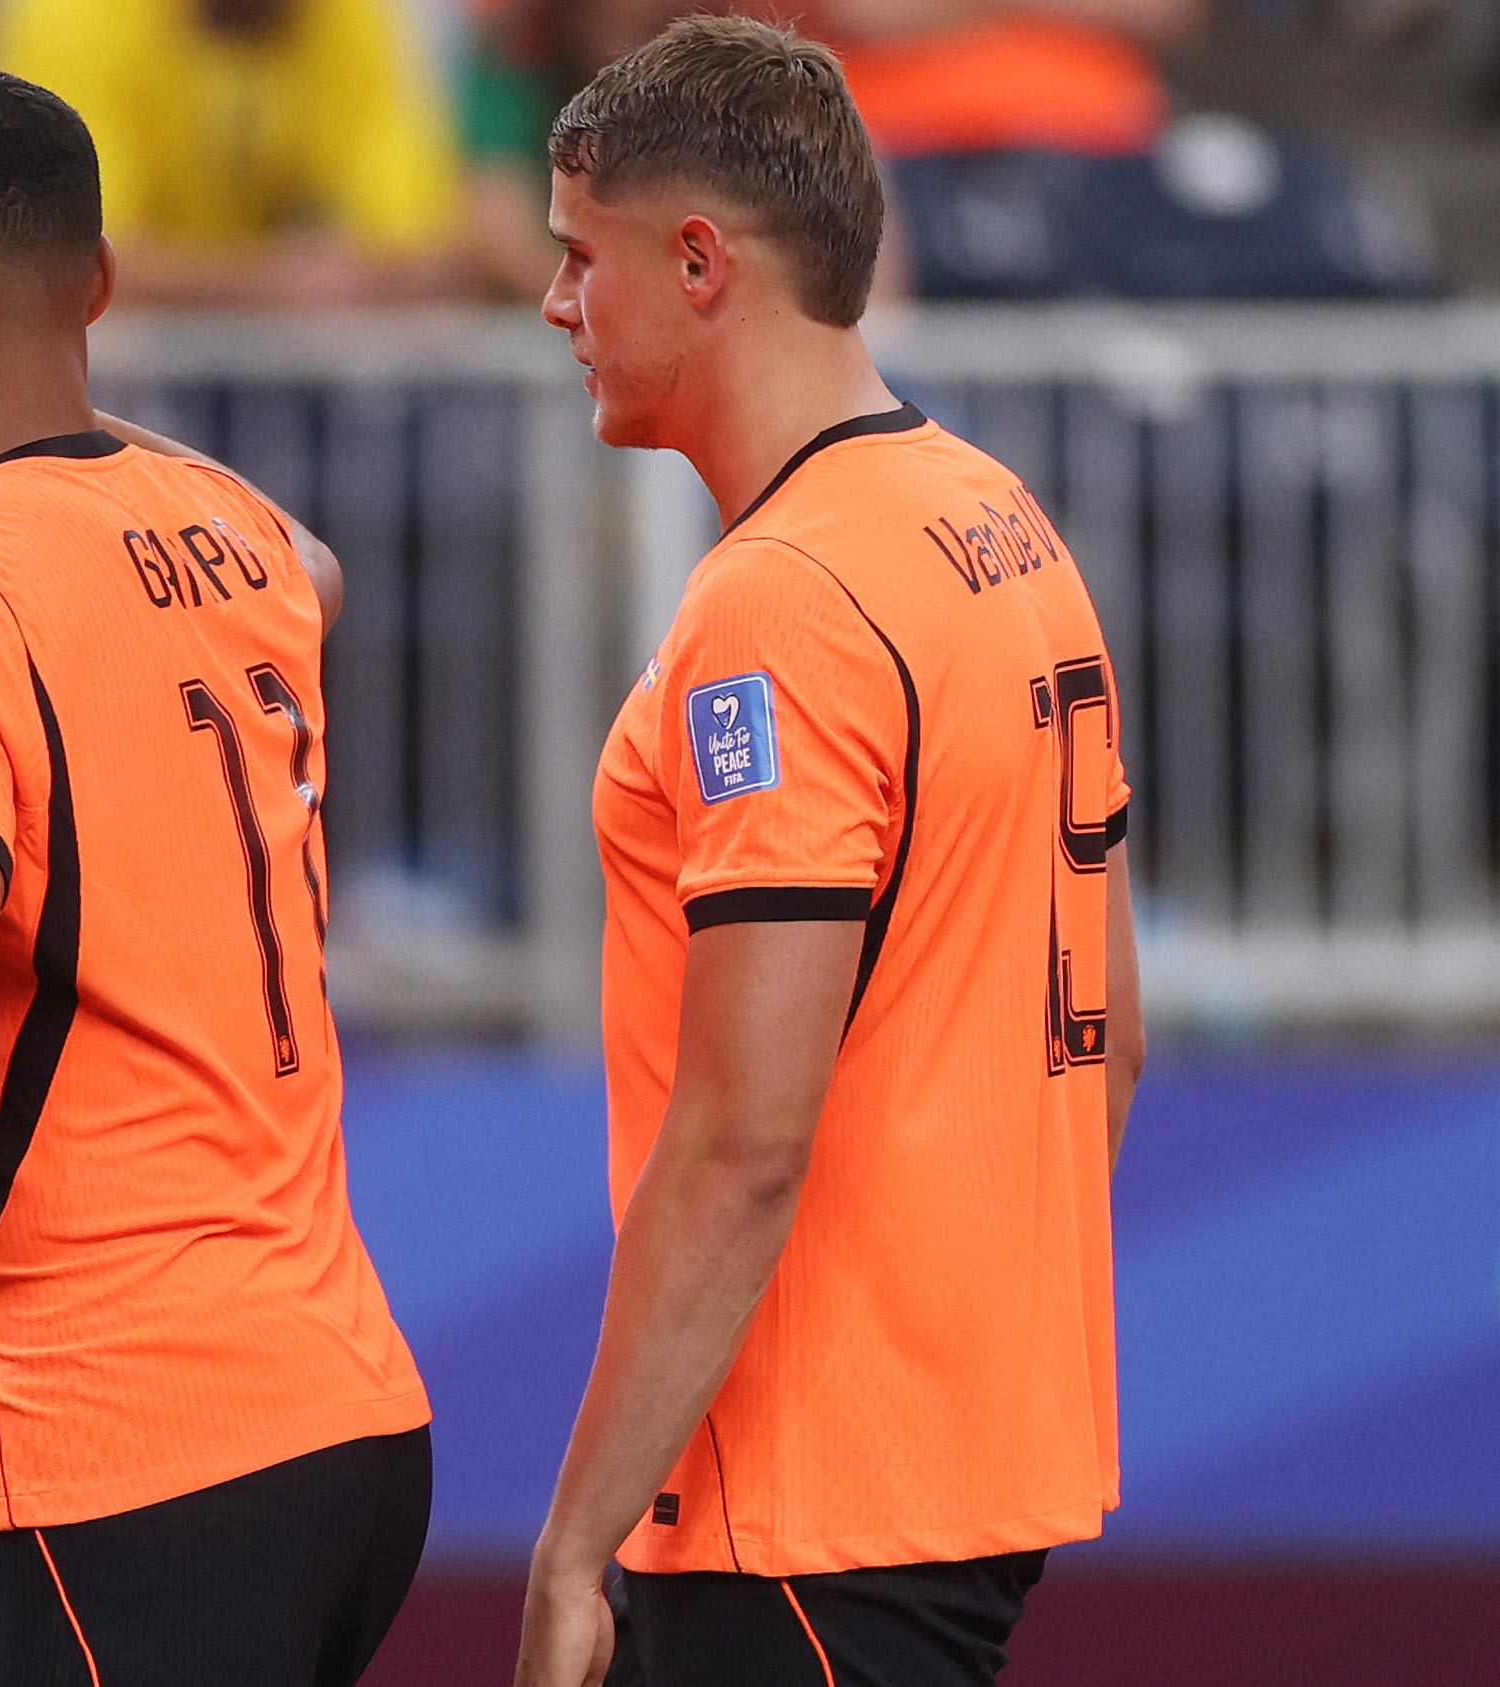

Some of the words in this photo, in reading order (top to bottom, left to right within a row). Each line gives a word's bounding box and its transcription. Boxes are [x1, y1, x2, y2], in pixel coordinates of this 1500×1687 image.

[708, 730, 736, 755] Unite
[734, 726, 751, 748] For
[713, 748, 751, 776] PEACE
[724, 773, 745, 787] FIFA
[179, 662, 328, 1079] 11
